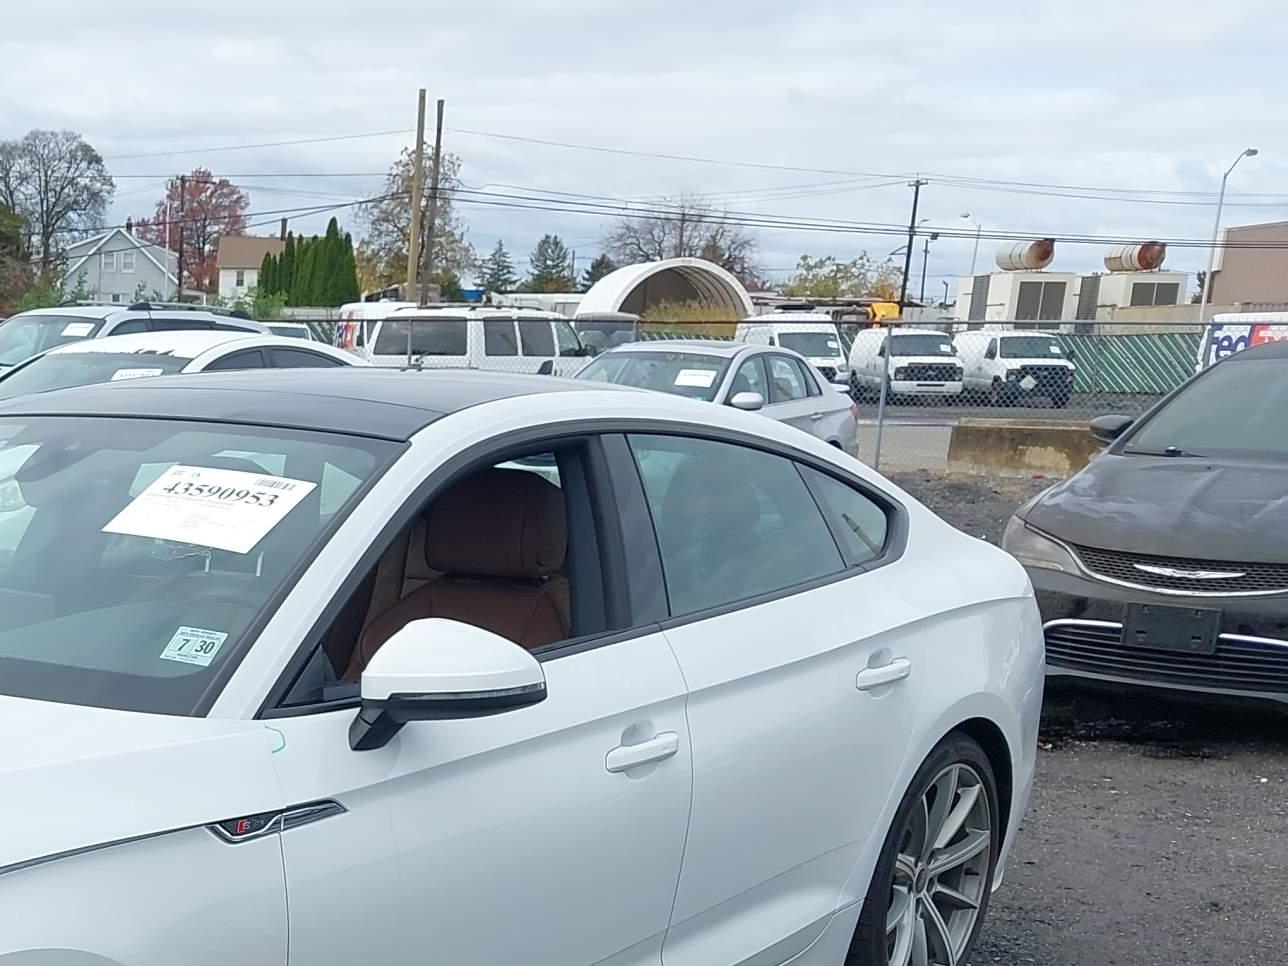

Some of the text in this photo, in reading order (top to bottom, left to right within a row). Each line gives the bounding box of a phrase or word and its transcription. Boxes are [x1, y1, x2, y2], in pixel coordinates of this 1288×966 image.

[162, 480, 280, 508] 43590953
[177, 638, 216, 654] 7 30
